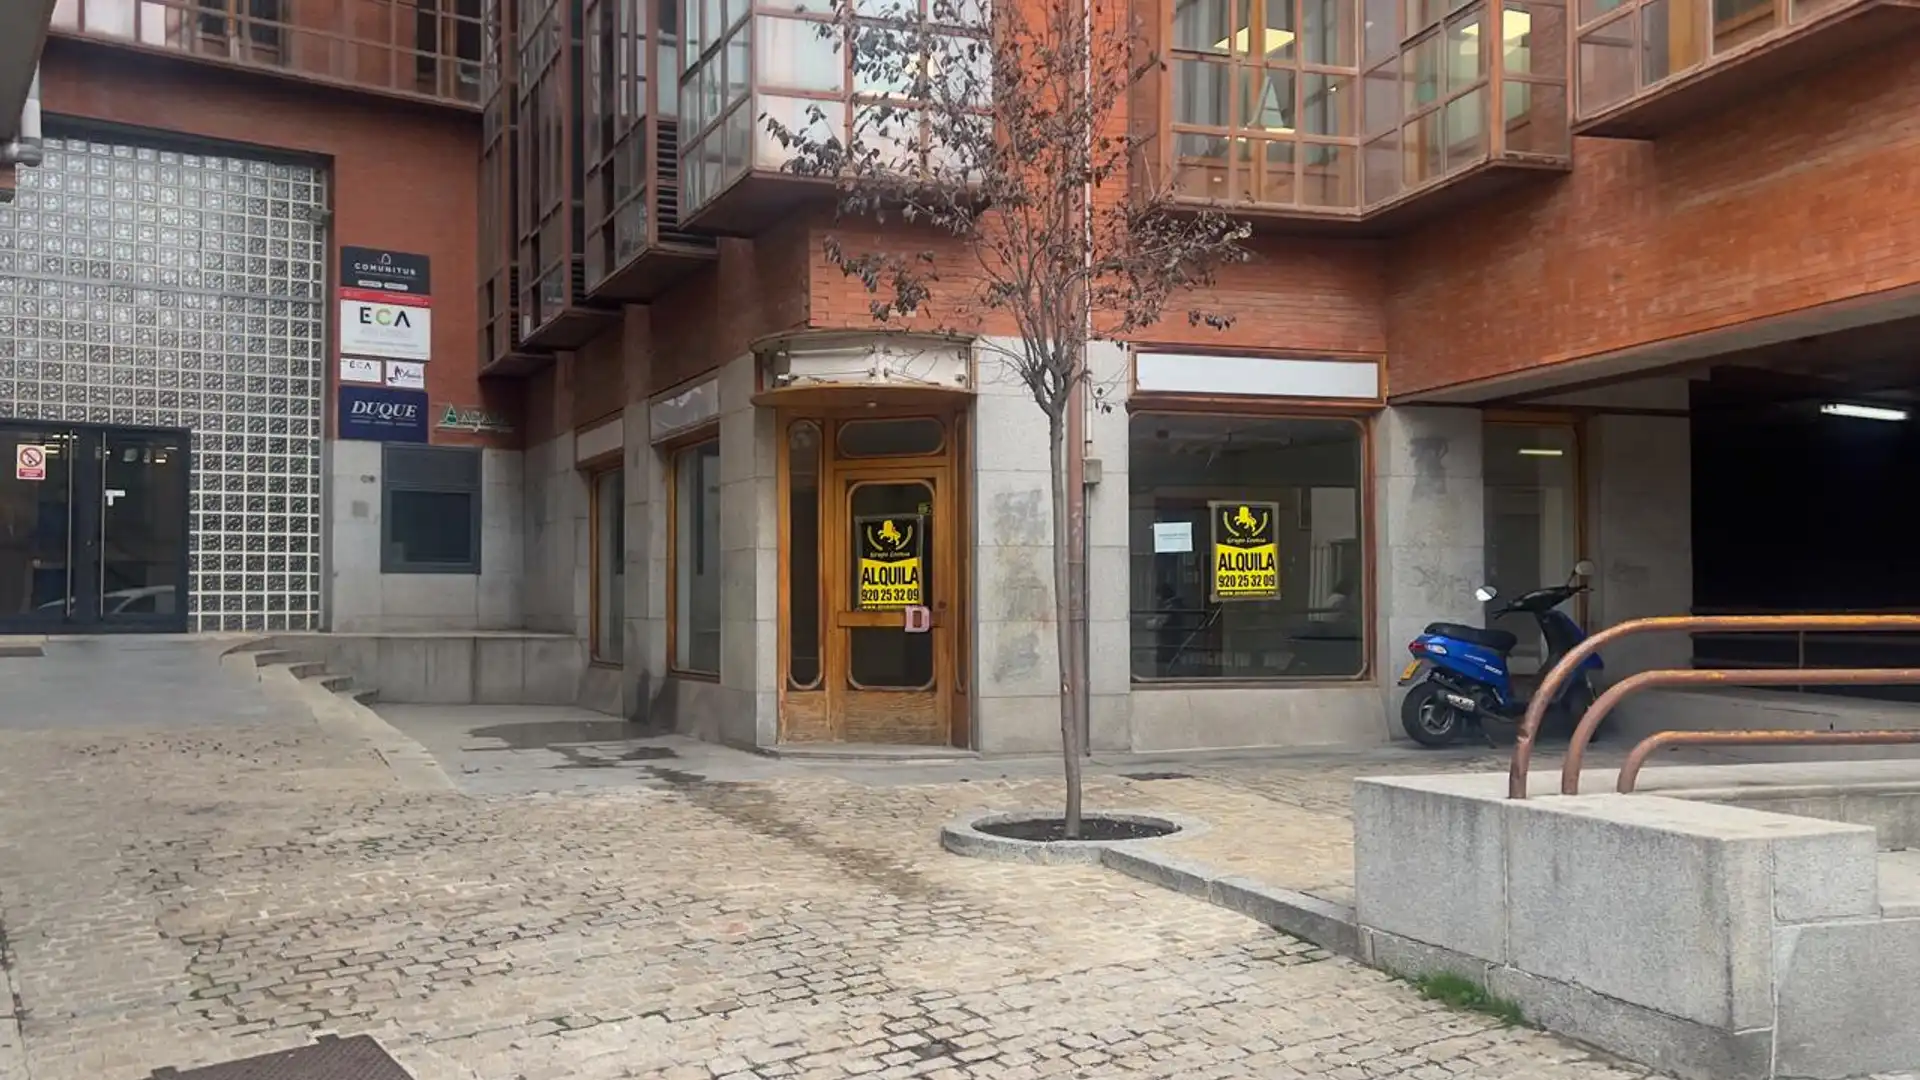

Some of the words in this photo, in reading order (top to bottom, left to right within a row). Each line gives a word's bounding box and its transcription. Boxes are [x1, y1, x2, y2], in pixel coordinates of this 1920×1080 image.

[360, 306, 411, 328] ECA
[351, 400, 418, 419] DUQUE
[1218, 552, 1276, 572] ALQUILA
[862, 567, 920, 586] ALQUILA
[1218, 574, 1236, 588] 920
[1237, 574, 1249, 587] 25
[1251, 574, 1262, 587] 32
[1263, 574, 1276, 587] 09
[861, 588, 878, 601] 920
[880, 588, 892, 601] 25
[894, 588, 905, 601] 32
[907, 588, 920, 601] 09
